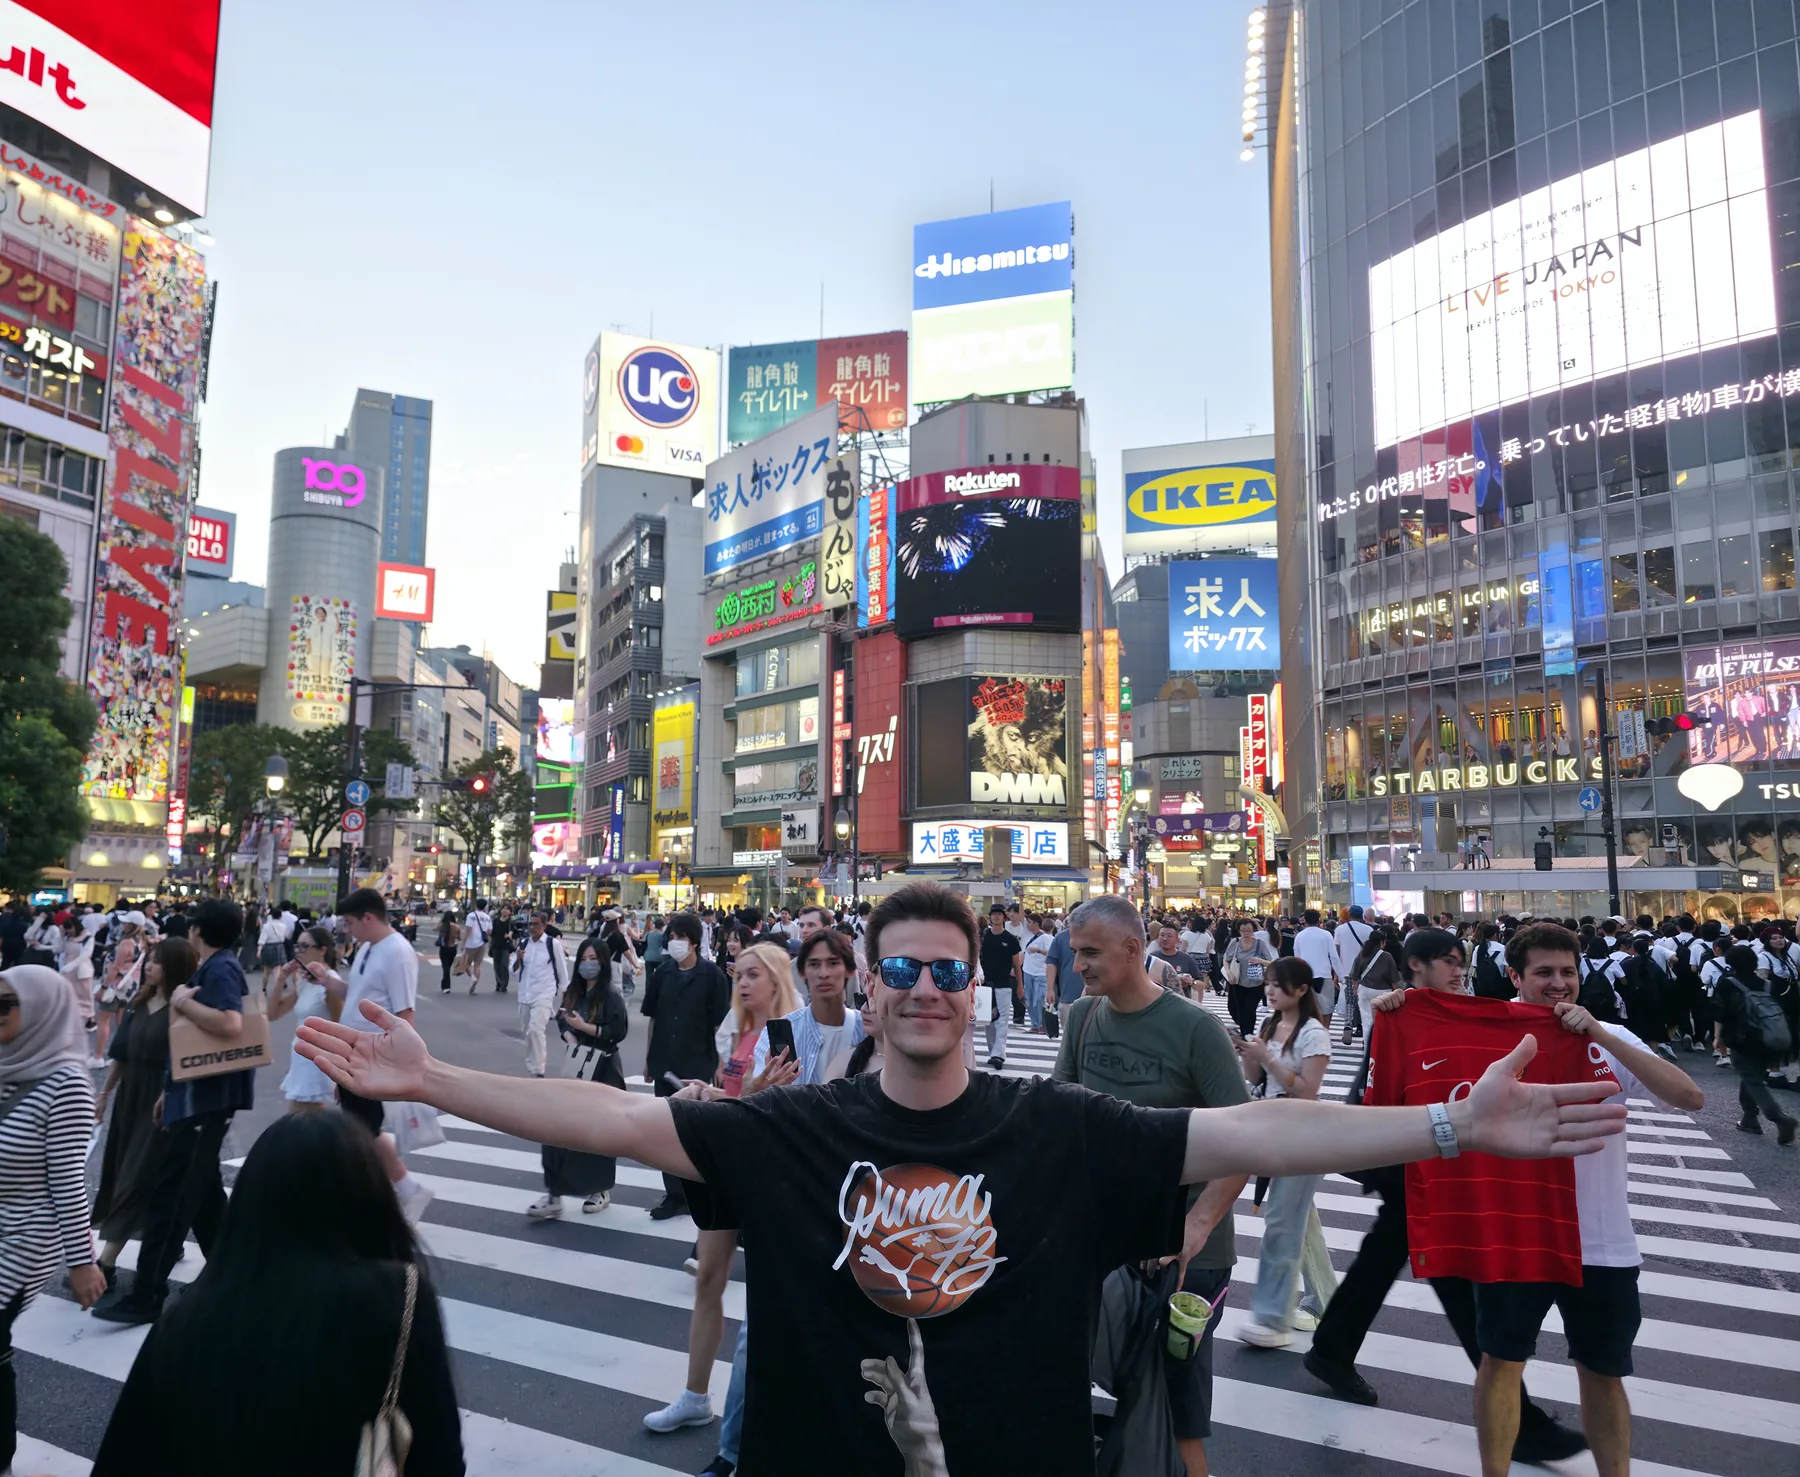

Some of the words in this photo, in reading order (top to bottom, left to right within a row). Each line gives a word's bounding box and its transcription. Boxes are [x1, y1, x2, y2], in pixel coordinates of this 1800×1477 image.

[18, 194, 109, 263] しゃぶ葉
[915, 242, 1068, 279] Hisamitsu
[1447, 272, 1509, 313] LIVE
[1525, 225, 1642, 285] JAPAN
[1550, 271, 1615, 302] TOKYO
[24, 327, 95, 374] ガスト
[747, 361, 799, 389] 龍角散
[836, 352, 892, 381] 龍角散
[628, 363, 692, 410] UC
[739, 387, 809, 414] ダイレクト
[829, 379, 901, 406] ダイレクト
[670, 447, 702, 463] VISA
[302, 457, 366, 507] 109
[708, 436, 831, 523] 求人ボックス
[944, 471, 1020, 492] Rakuten
[303, 490, 343, 507] SHIBUYA
[1143, 478, 1275, 513] IKEA
[189, 518, 222, 541] UNI
[825, 459, 854, 600] もんじゃ
[188, 538, 224, 559] QLO
[867, 490, 883, 618] 三千里薬品
[741, 590, 775, 621] 西村
[1184, 577, 1266, 619] 求人
[1184, 625, 1267, 653] ボックス
[1251, 703, 1266, 767] カラオケ
[1162, 769, 1201, 778] クリニック
[1172, 758, 1200, 767] れいわ
[971, 771, 1066, 804] DMM
[1759, 783, 1800, 799] TSU
[920, 828, 1056, 854] 大盛堂書店
[180, 1044, 264, 1069] CONVERSE
[1087, 1051, 1154, 1075] REPLAY
[832, 1161, 992, 1270] Puma
